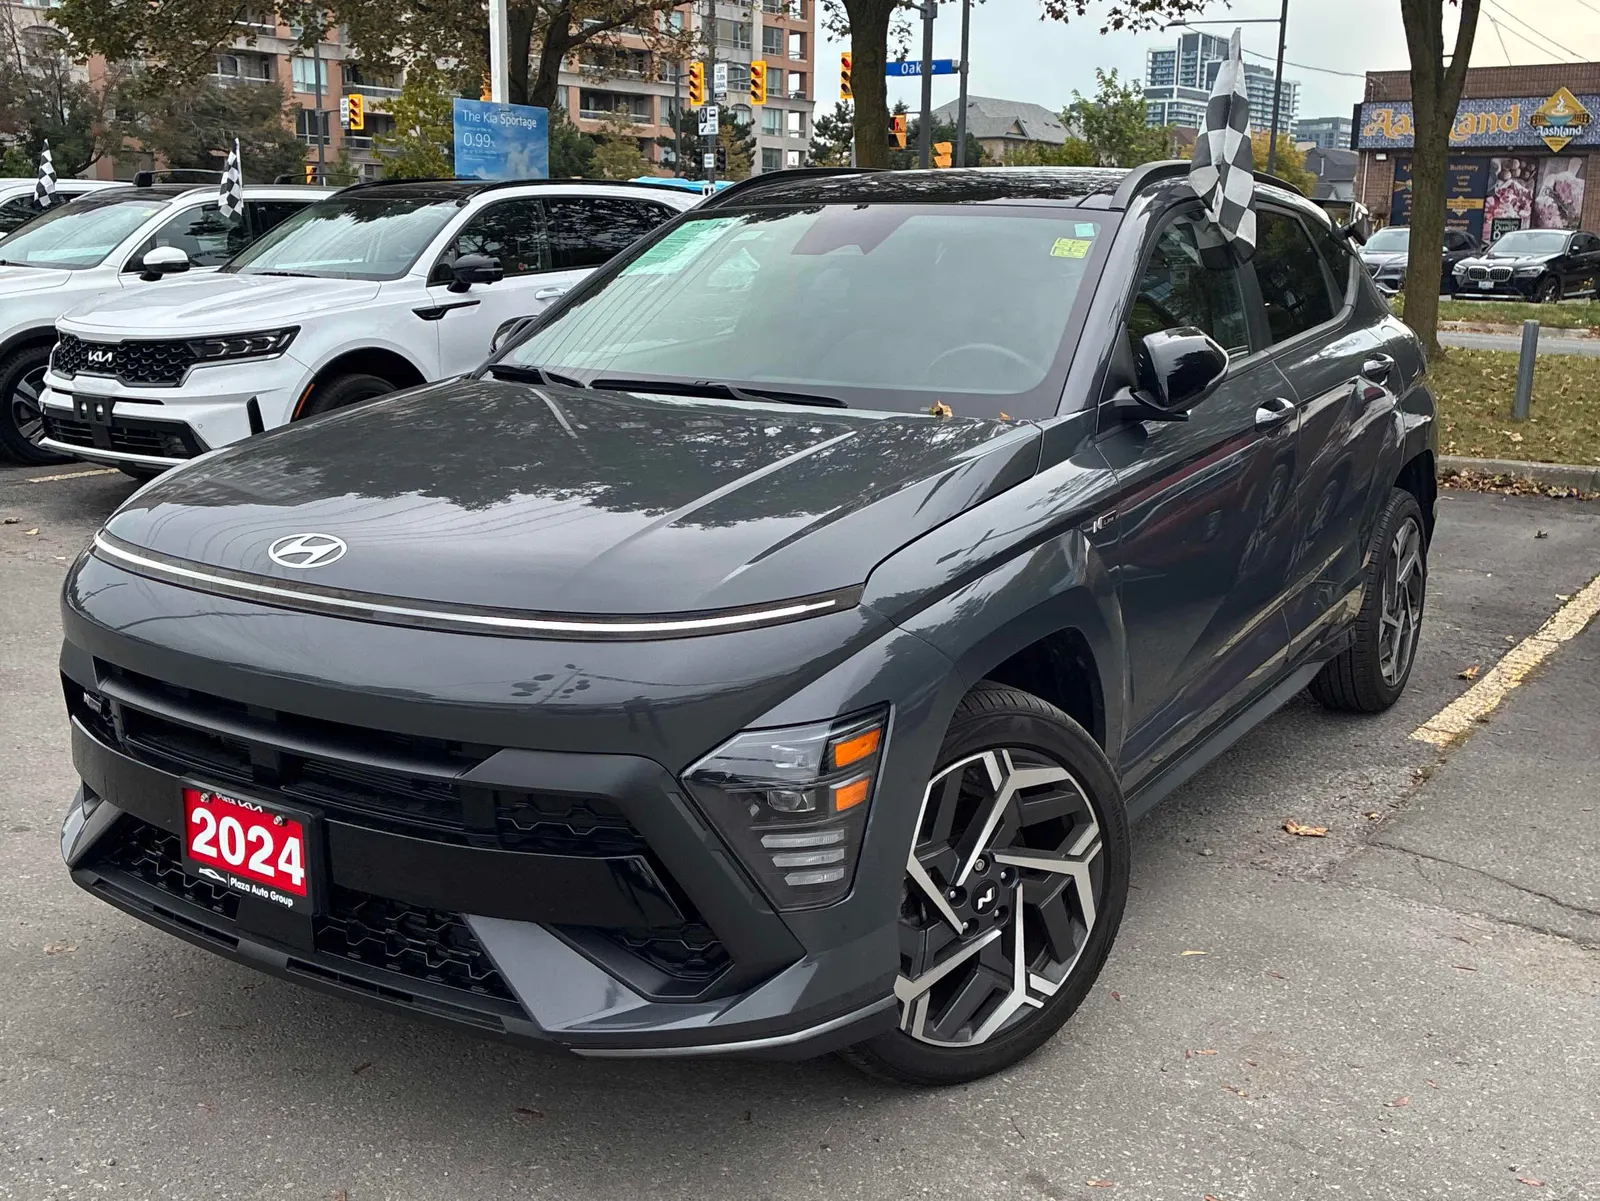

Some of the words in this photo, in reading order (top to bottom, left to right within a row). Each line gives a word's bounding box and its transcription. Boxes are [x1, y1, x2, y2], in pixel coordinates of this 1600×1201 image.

[462, 110, 481, 122] The
[483, 112, 498, 124] Kia
[500, 113, 537, 130] Sportage
[191, 807, 305, 886] 2024
[230, 877, 251, 892] Plaza
[251, 884, 269, 899] Auto
[270, 891, 294, 908] Group
